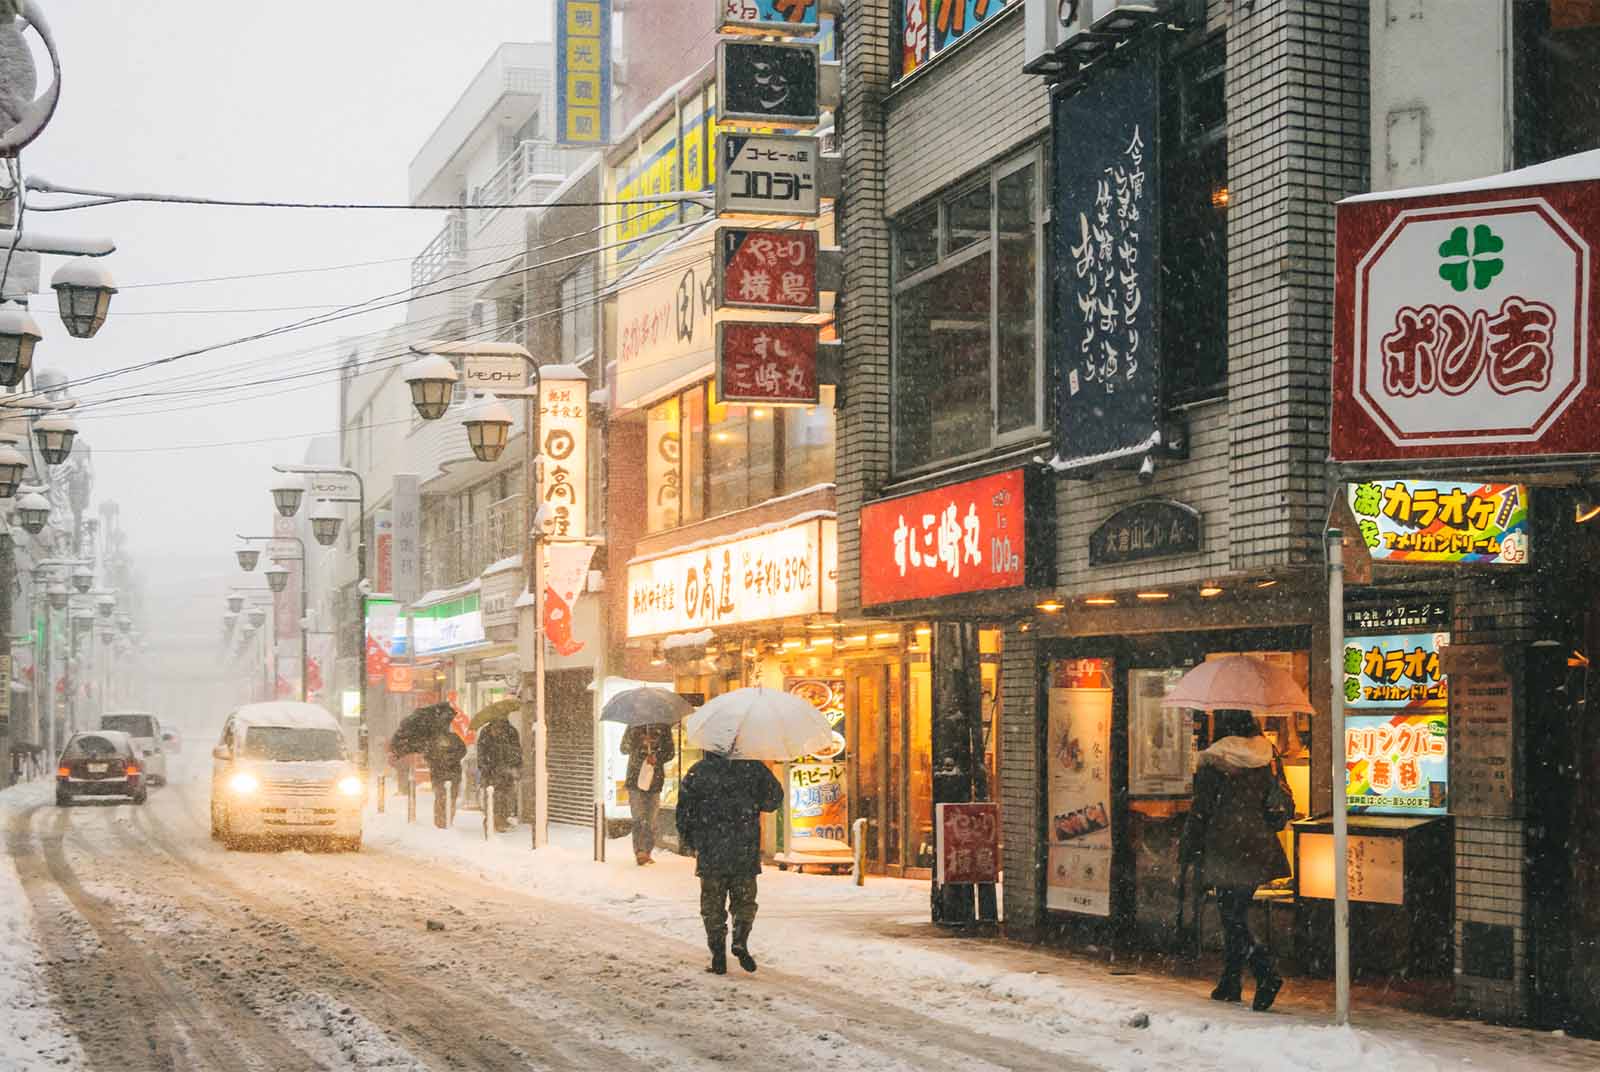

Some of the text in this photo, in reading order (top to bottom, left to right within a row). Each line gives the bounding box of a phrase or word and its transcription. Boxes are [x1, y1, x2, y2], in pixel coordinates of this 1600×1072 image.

[730, 169, 814, 201] コロラド
[1380, 295, 1557, 398] ポン吉
[1383, 481, 1497, 531] カラオケ
[893, 500, 983, 578] すし三崎丸
[1382, 531, 1501, 554] アメリカンドリーム
[684, 550, 735, 620] 日高屋
[1363, 645, 1441, 685] カラオケ
[1362, 685, 1448, 701] アメリカンドリーム
[1346, 727, 1446, 758] ドリンクバー
[1371, 759, 1418, 790] 無料
